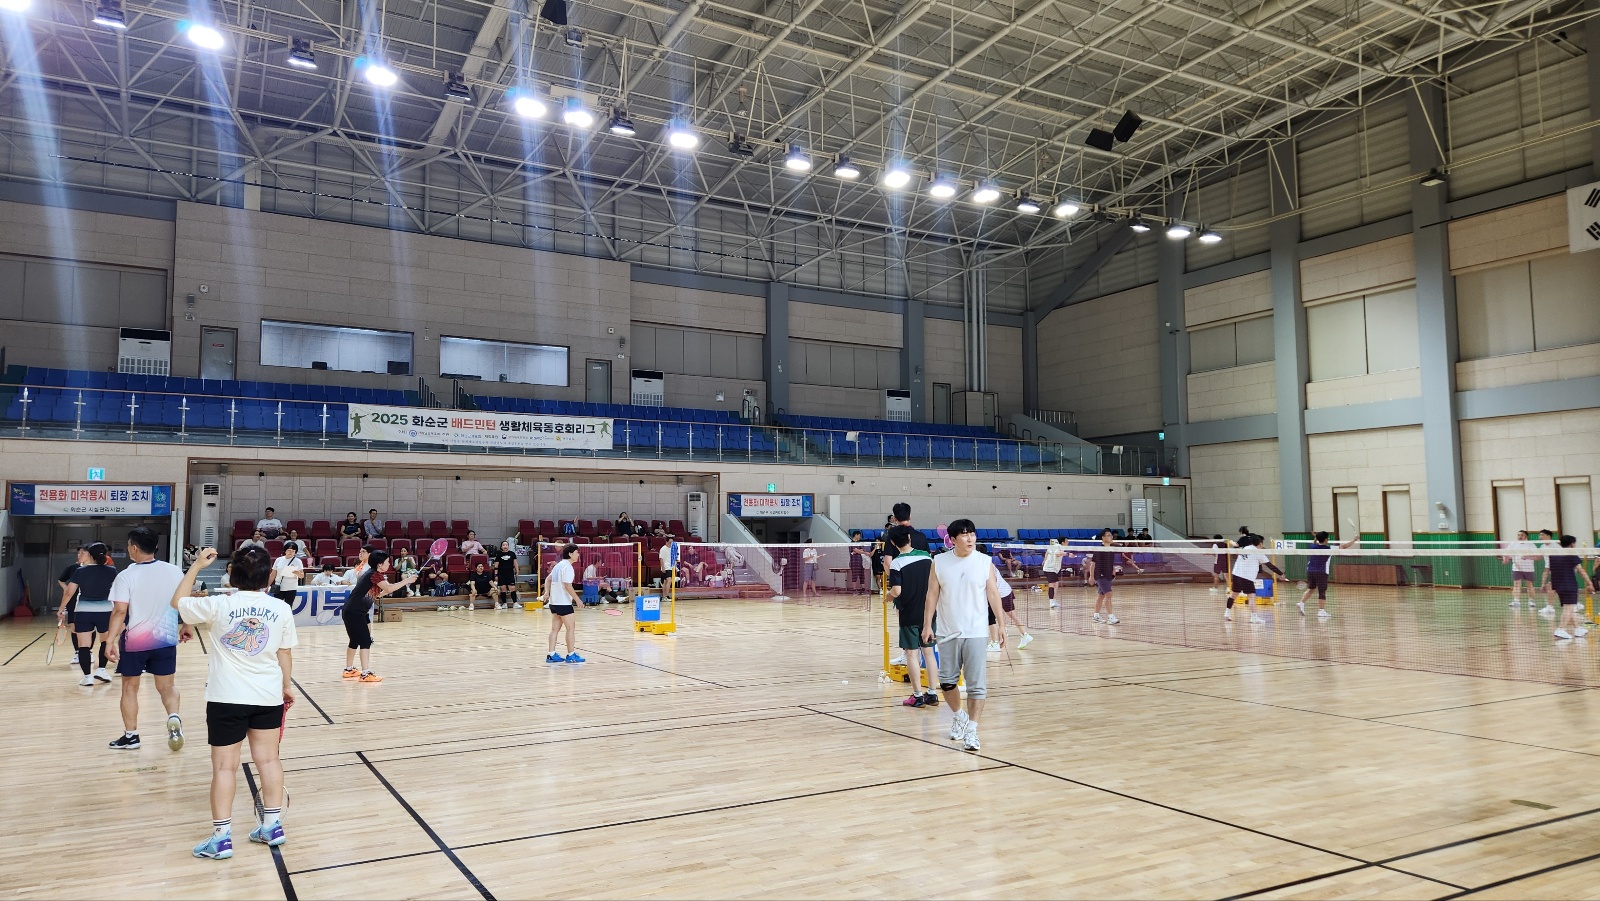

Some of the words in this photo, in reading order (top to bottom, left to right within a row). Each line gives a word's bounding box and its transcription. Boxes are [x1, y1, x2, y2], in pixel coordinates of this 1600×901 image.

[371, 412, 409, 425] 2025
[411, 415, 448, 428] 화순군
[451, 417, 496, 430] 배드민턴
[499, 420, 596, 434] 생활체육동호회리그
[39, 489, 67, 501] 전용화
[70, 490, 108, 501] 미착용시
[110, 490, 129, 502] 퇴장
[131, 490, 150, 502] 조치
[228, 606, 279, 625] SUNBURN
